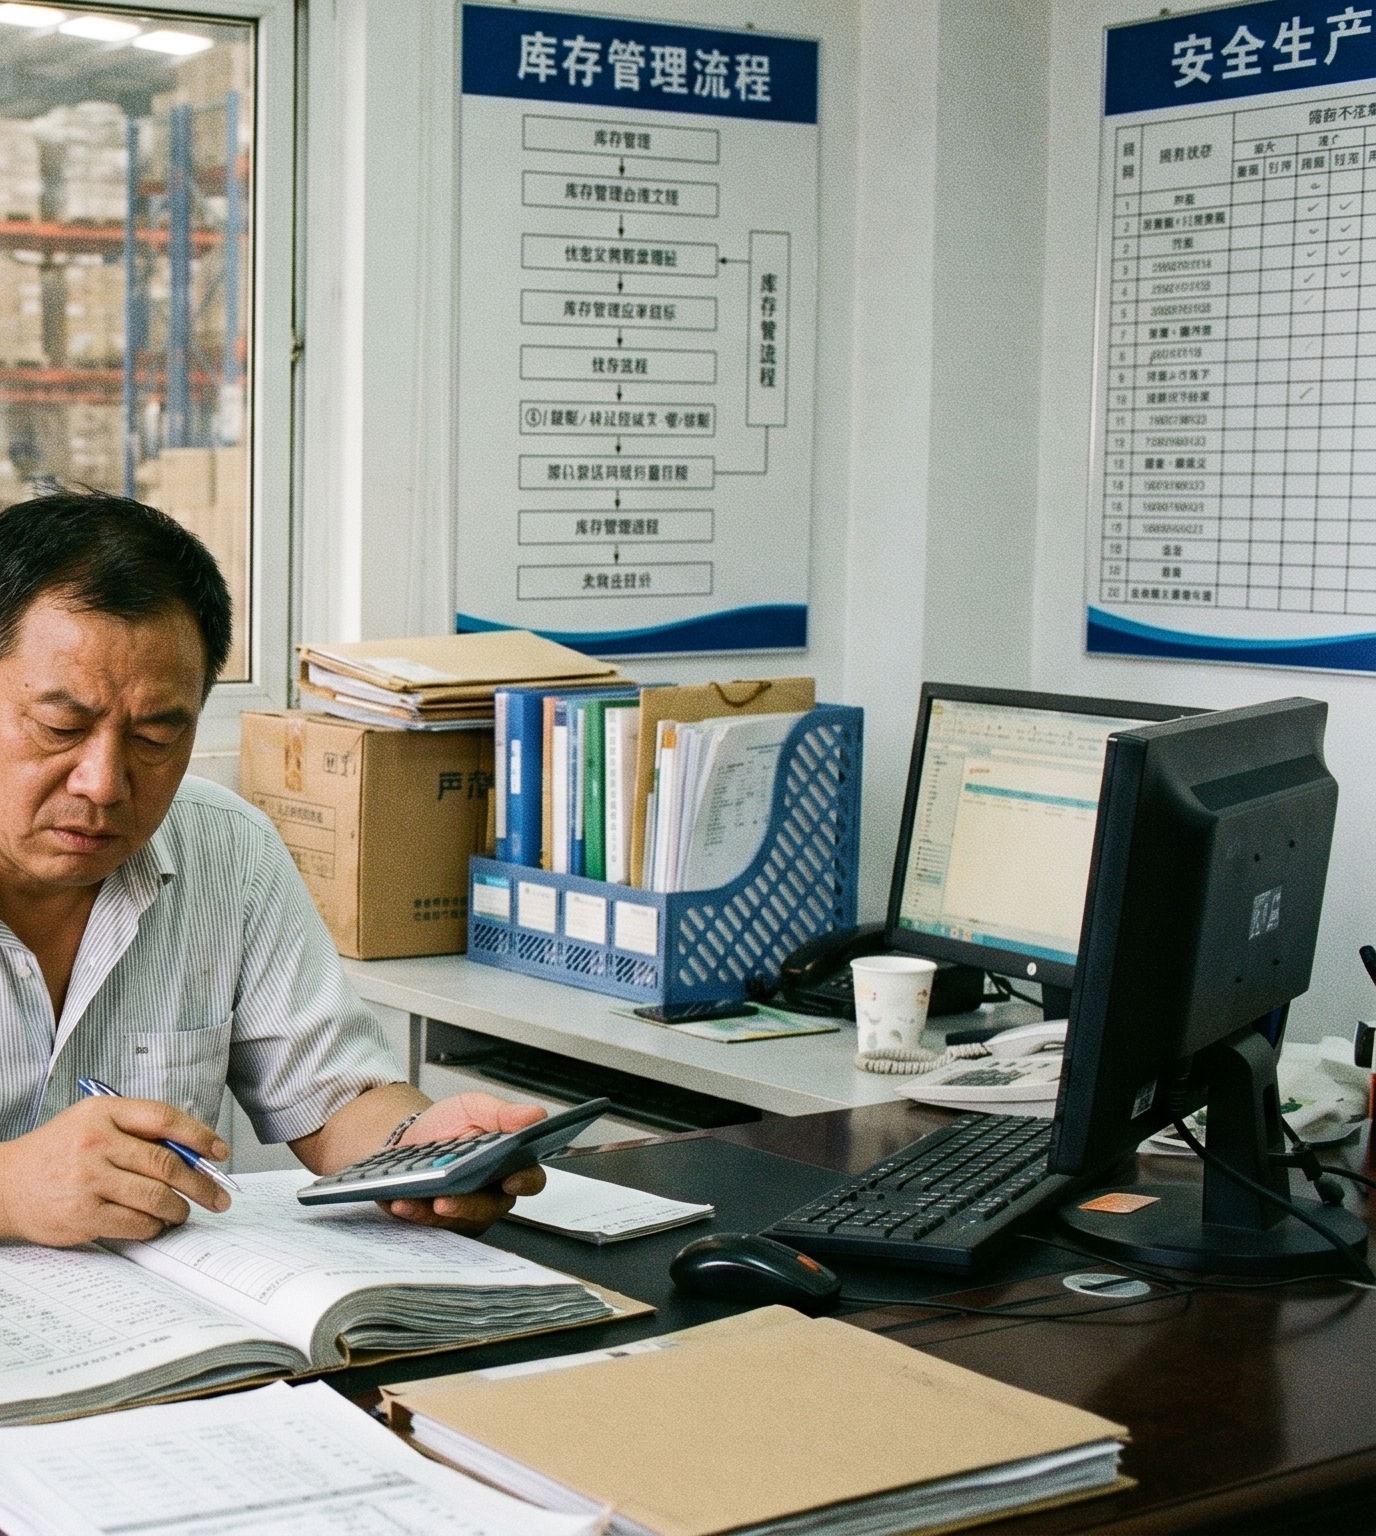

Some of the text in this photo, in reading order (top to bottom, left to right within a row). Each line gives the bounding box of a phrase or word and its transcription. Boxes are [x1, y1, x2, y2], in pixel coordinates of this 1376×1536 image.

[517, 31, 772, 102] 库存管理流程
[1170, 6, 1373, 88] 安全生产
[593, 129, 652, 150] 库存管理
[759, 272, 778, 388] 库存管流程
